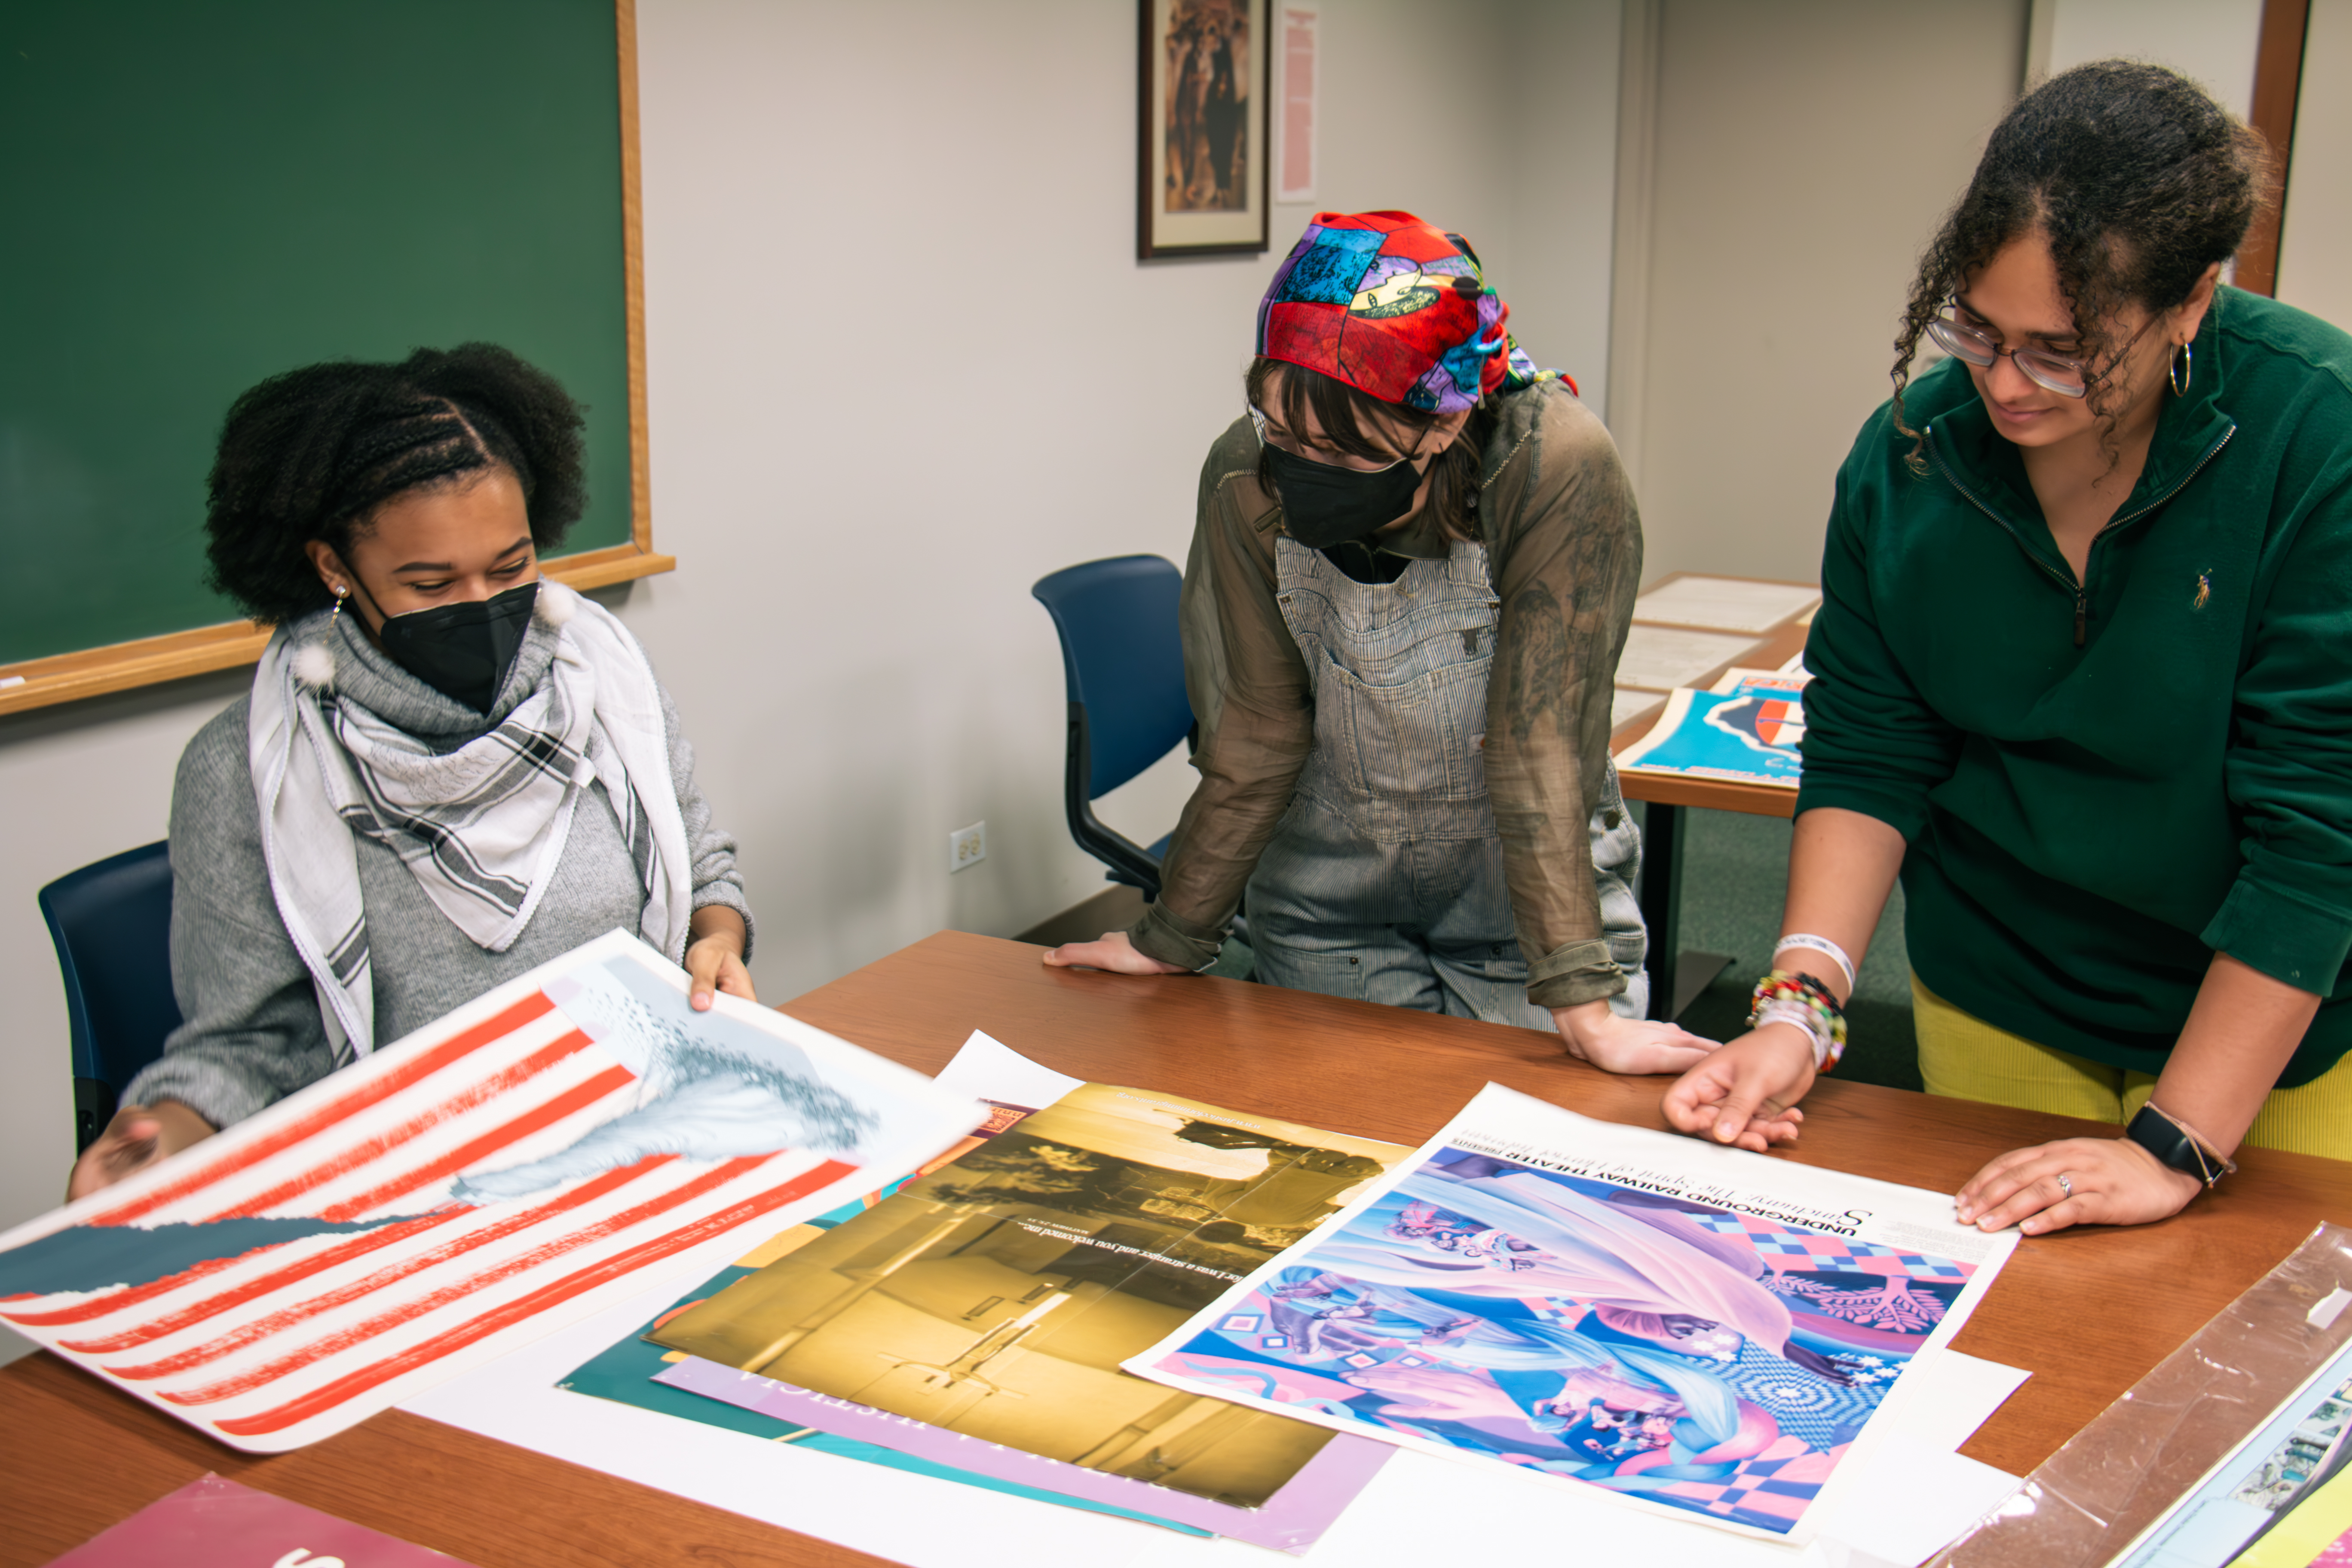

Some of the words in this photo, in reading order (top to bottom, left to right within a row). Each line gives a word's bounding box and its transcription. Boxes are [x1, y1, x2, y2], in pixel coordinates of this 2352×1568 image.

[1116, 1092, 1261, 1130] www.justiceforimmigrants.org
[1452, 1137, 1503, 1155] PRESENTS
[1506, 1152, 1589, 1176] THEATER
[1613, 1162, 1634, 1172] of
[1592, 1172, 1682, 1196] RAILWAY
[1638, 1170, 1695, 1189] Spirit
[1698, 1185, 1735, 1200] The
[1686, 1192, 1857, 1237] UNDERGROUND
[1745, 1194, 1873, 1226] Sanctuary:
[1038, 1228, 1095, 1246] welcomed
[1050, 1223, 1090, 1234] MATTHEW
[1094, 1240, 1120, 1250] you
[1114, 1245, 1140, 1255] and
[1138, 1250, 1187, 1267] stranger
[1194, 1265, 1219, 1276] was
[1224, 1272, 1244, 1283] for
